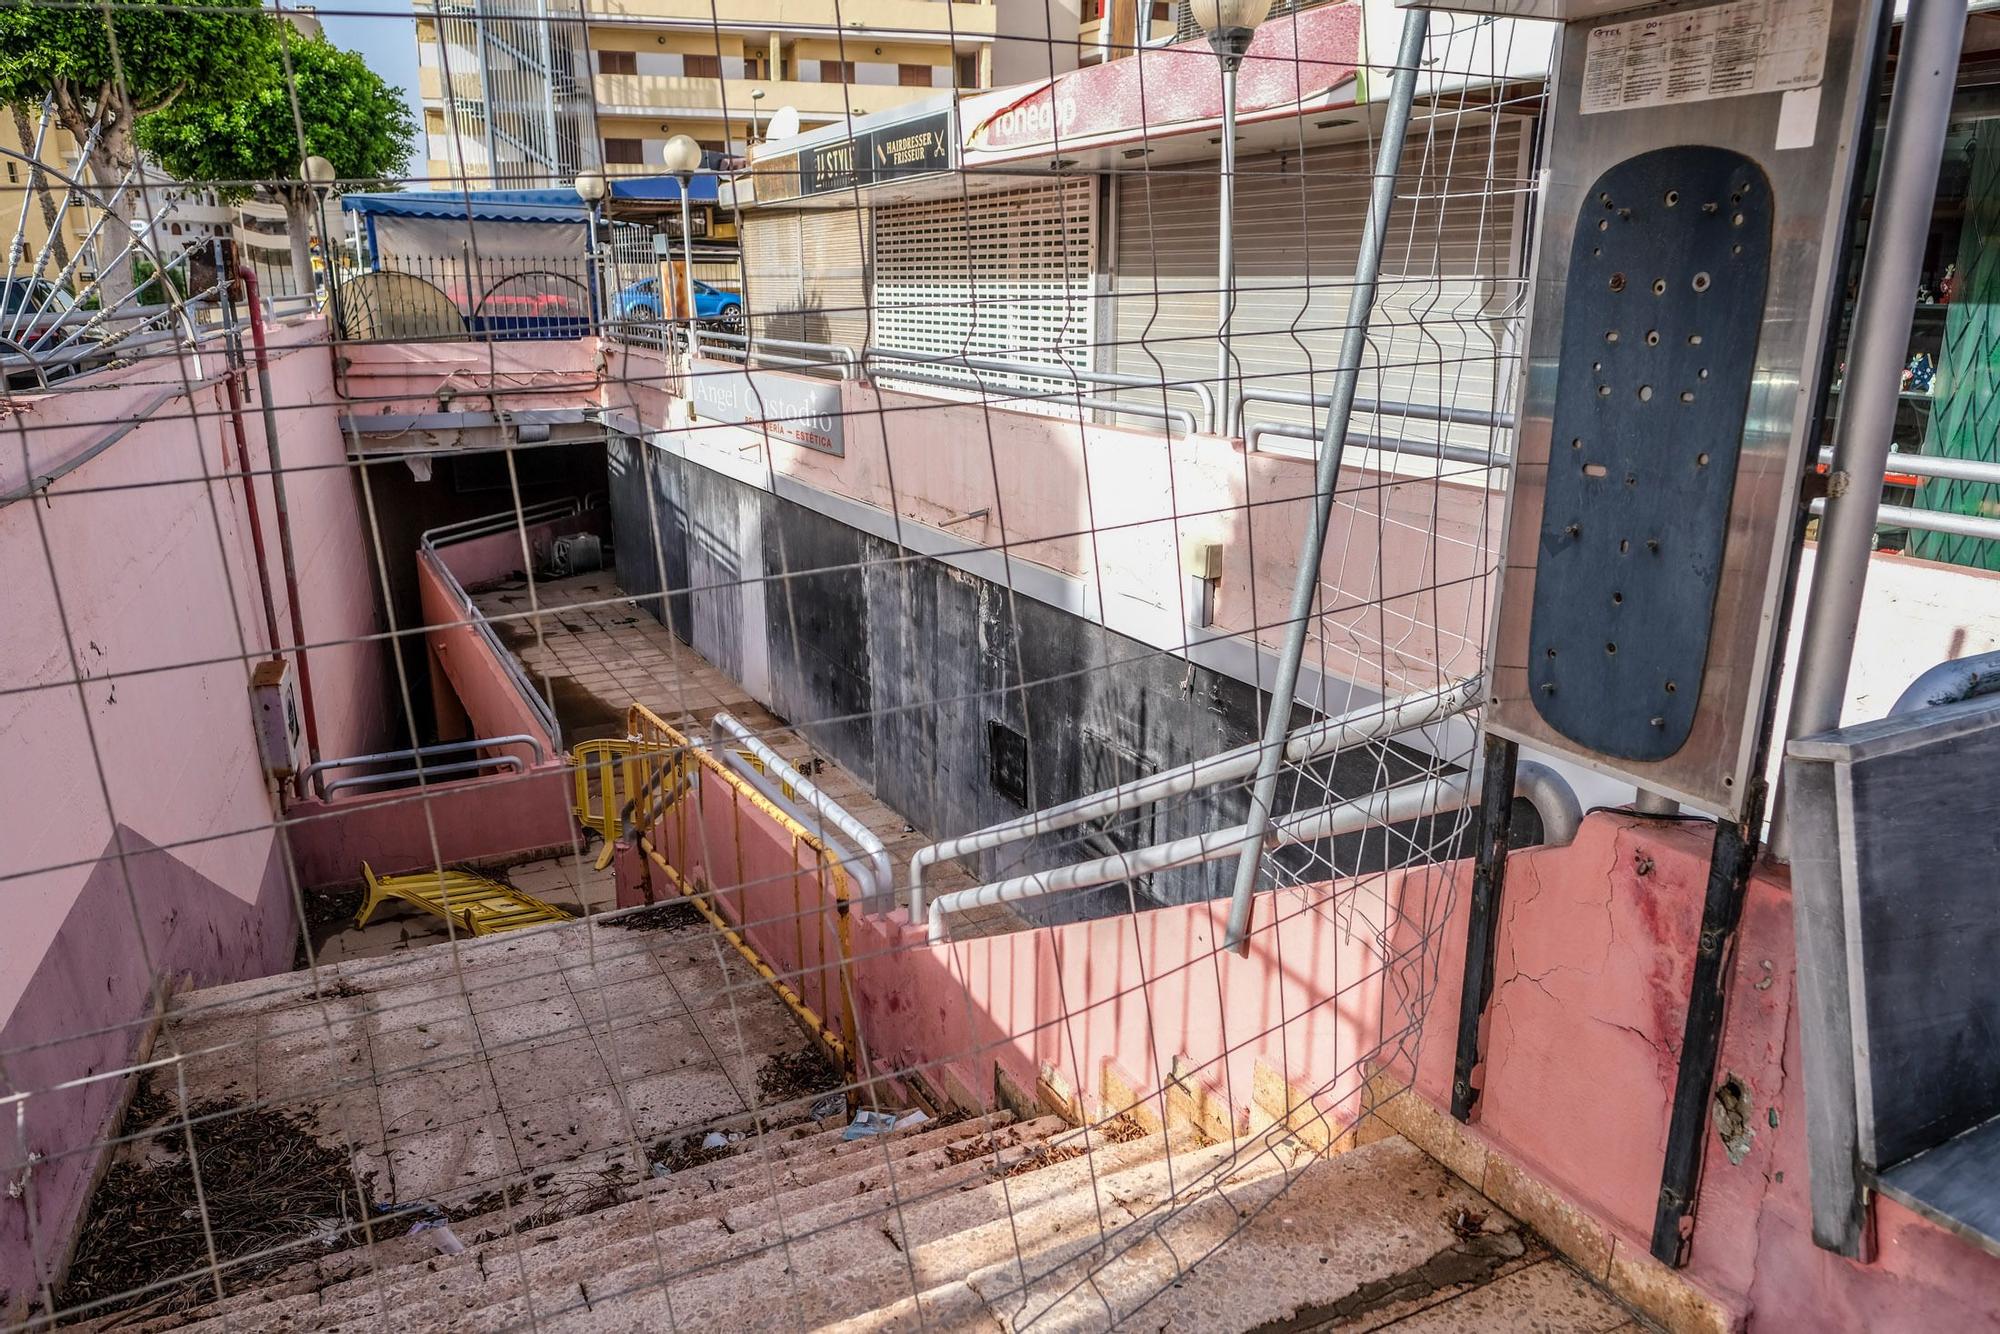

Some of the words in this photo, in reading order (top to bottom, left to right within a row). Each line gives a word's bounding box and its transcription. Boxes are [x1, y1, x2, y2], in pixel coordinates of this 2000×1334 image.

[886, 132, 932, 154] HAIRDRESSER
[827, 146, 854, 178] STYLE
[893, 147, 925, 165] FRISSEUR
[696, 378, 737, 412] Angel
[744, 386, 832, 432] Custodio
[795, 429, 833, 448] ESTÉTICA
